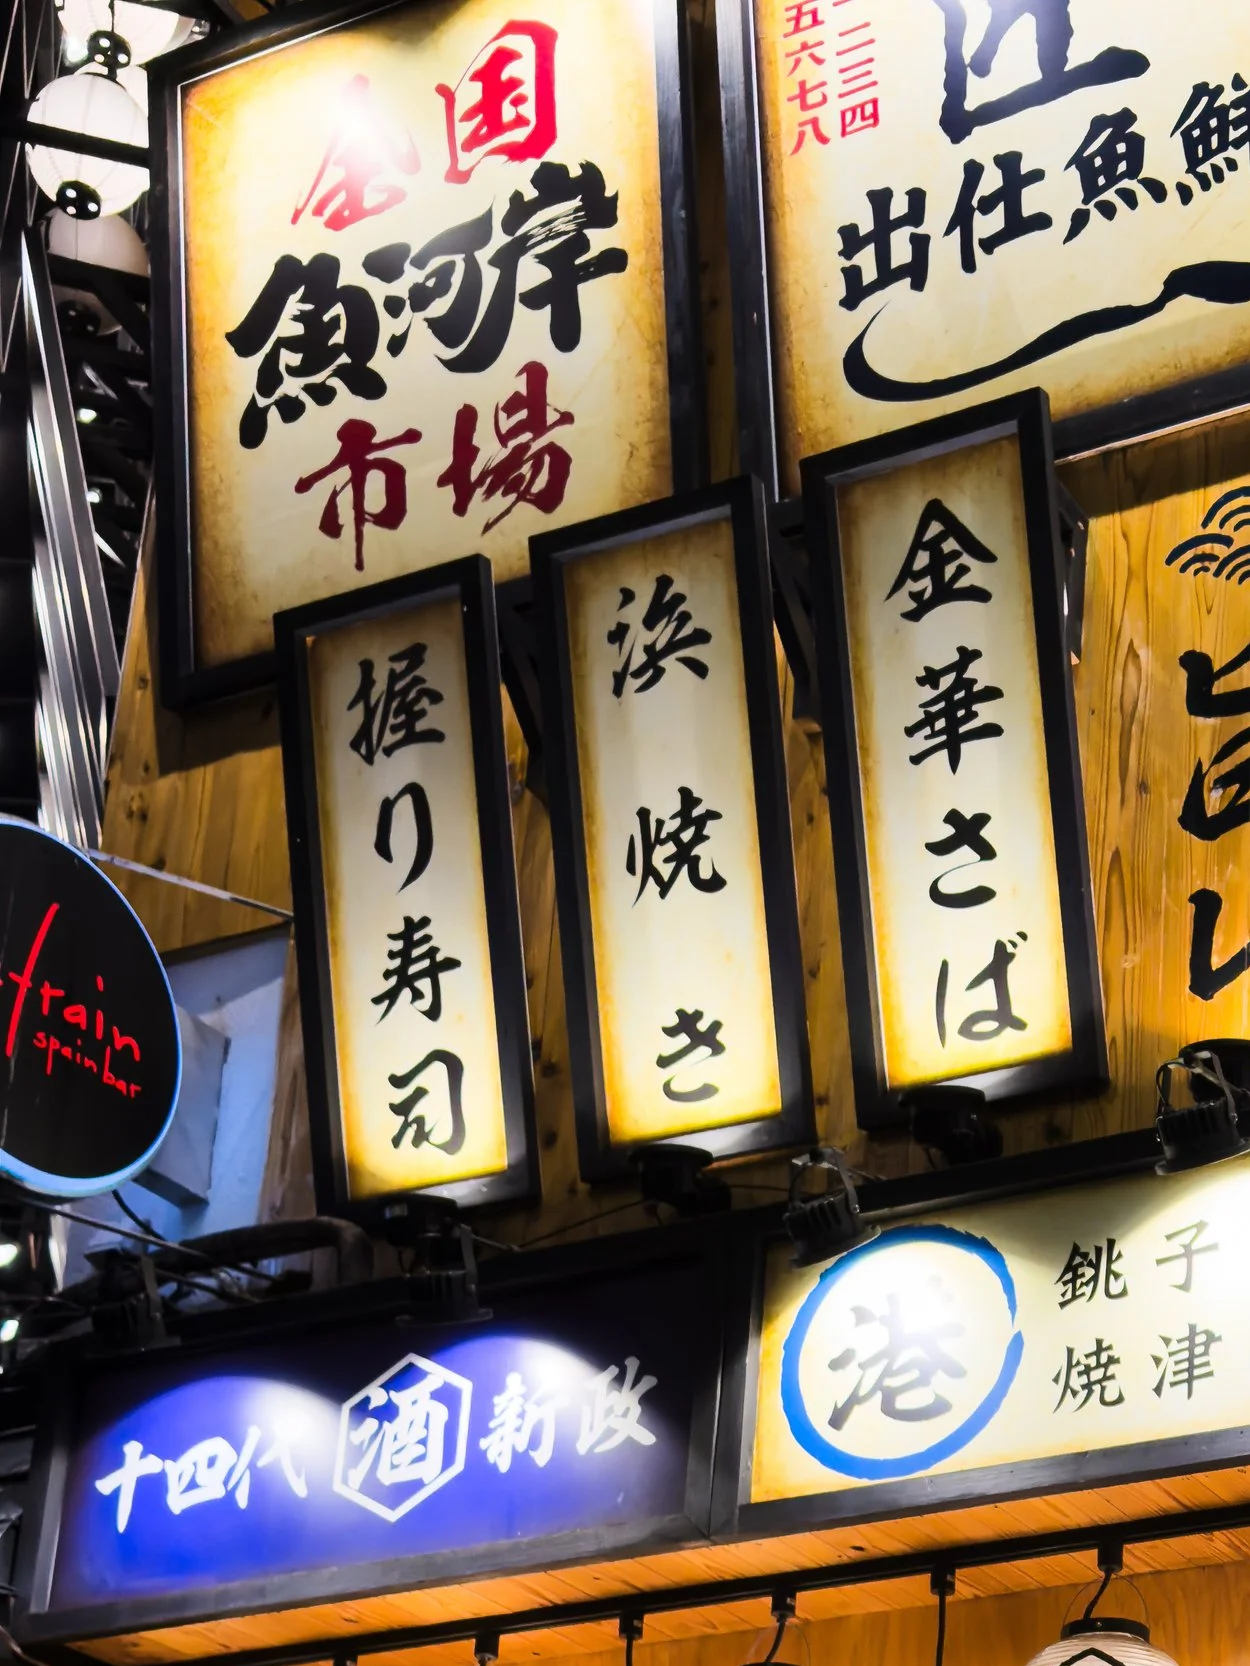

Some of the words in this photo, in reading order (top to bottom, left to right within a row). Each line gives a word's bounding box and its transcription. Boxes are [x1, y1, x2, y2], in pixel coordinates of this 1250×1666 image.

[292, 20, 558, 231] 全国
[225, 159, 628, 449] 魚河岸
[295, 361, 574, 571] 市場
[606, 574, 728, 1104] 浜焼き
[884, 498, 1028, 1049] 金華さば
[346, 642, 466, 1156] 握り寿司
[33, 1032, 97, 1074] spain
[103, 1046, 141, 1098] bar
[828, 1275, 969, 1433] 港
[1052, 1322, 1223, 1415] 焼津
[1054, 1220, 1220, 1311] 銚子
[96, 1426, 309, 1534] 十四代
[349, 1373, 450, 1493] 酒
[479, 1357, 659, 1473] 新政
